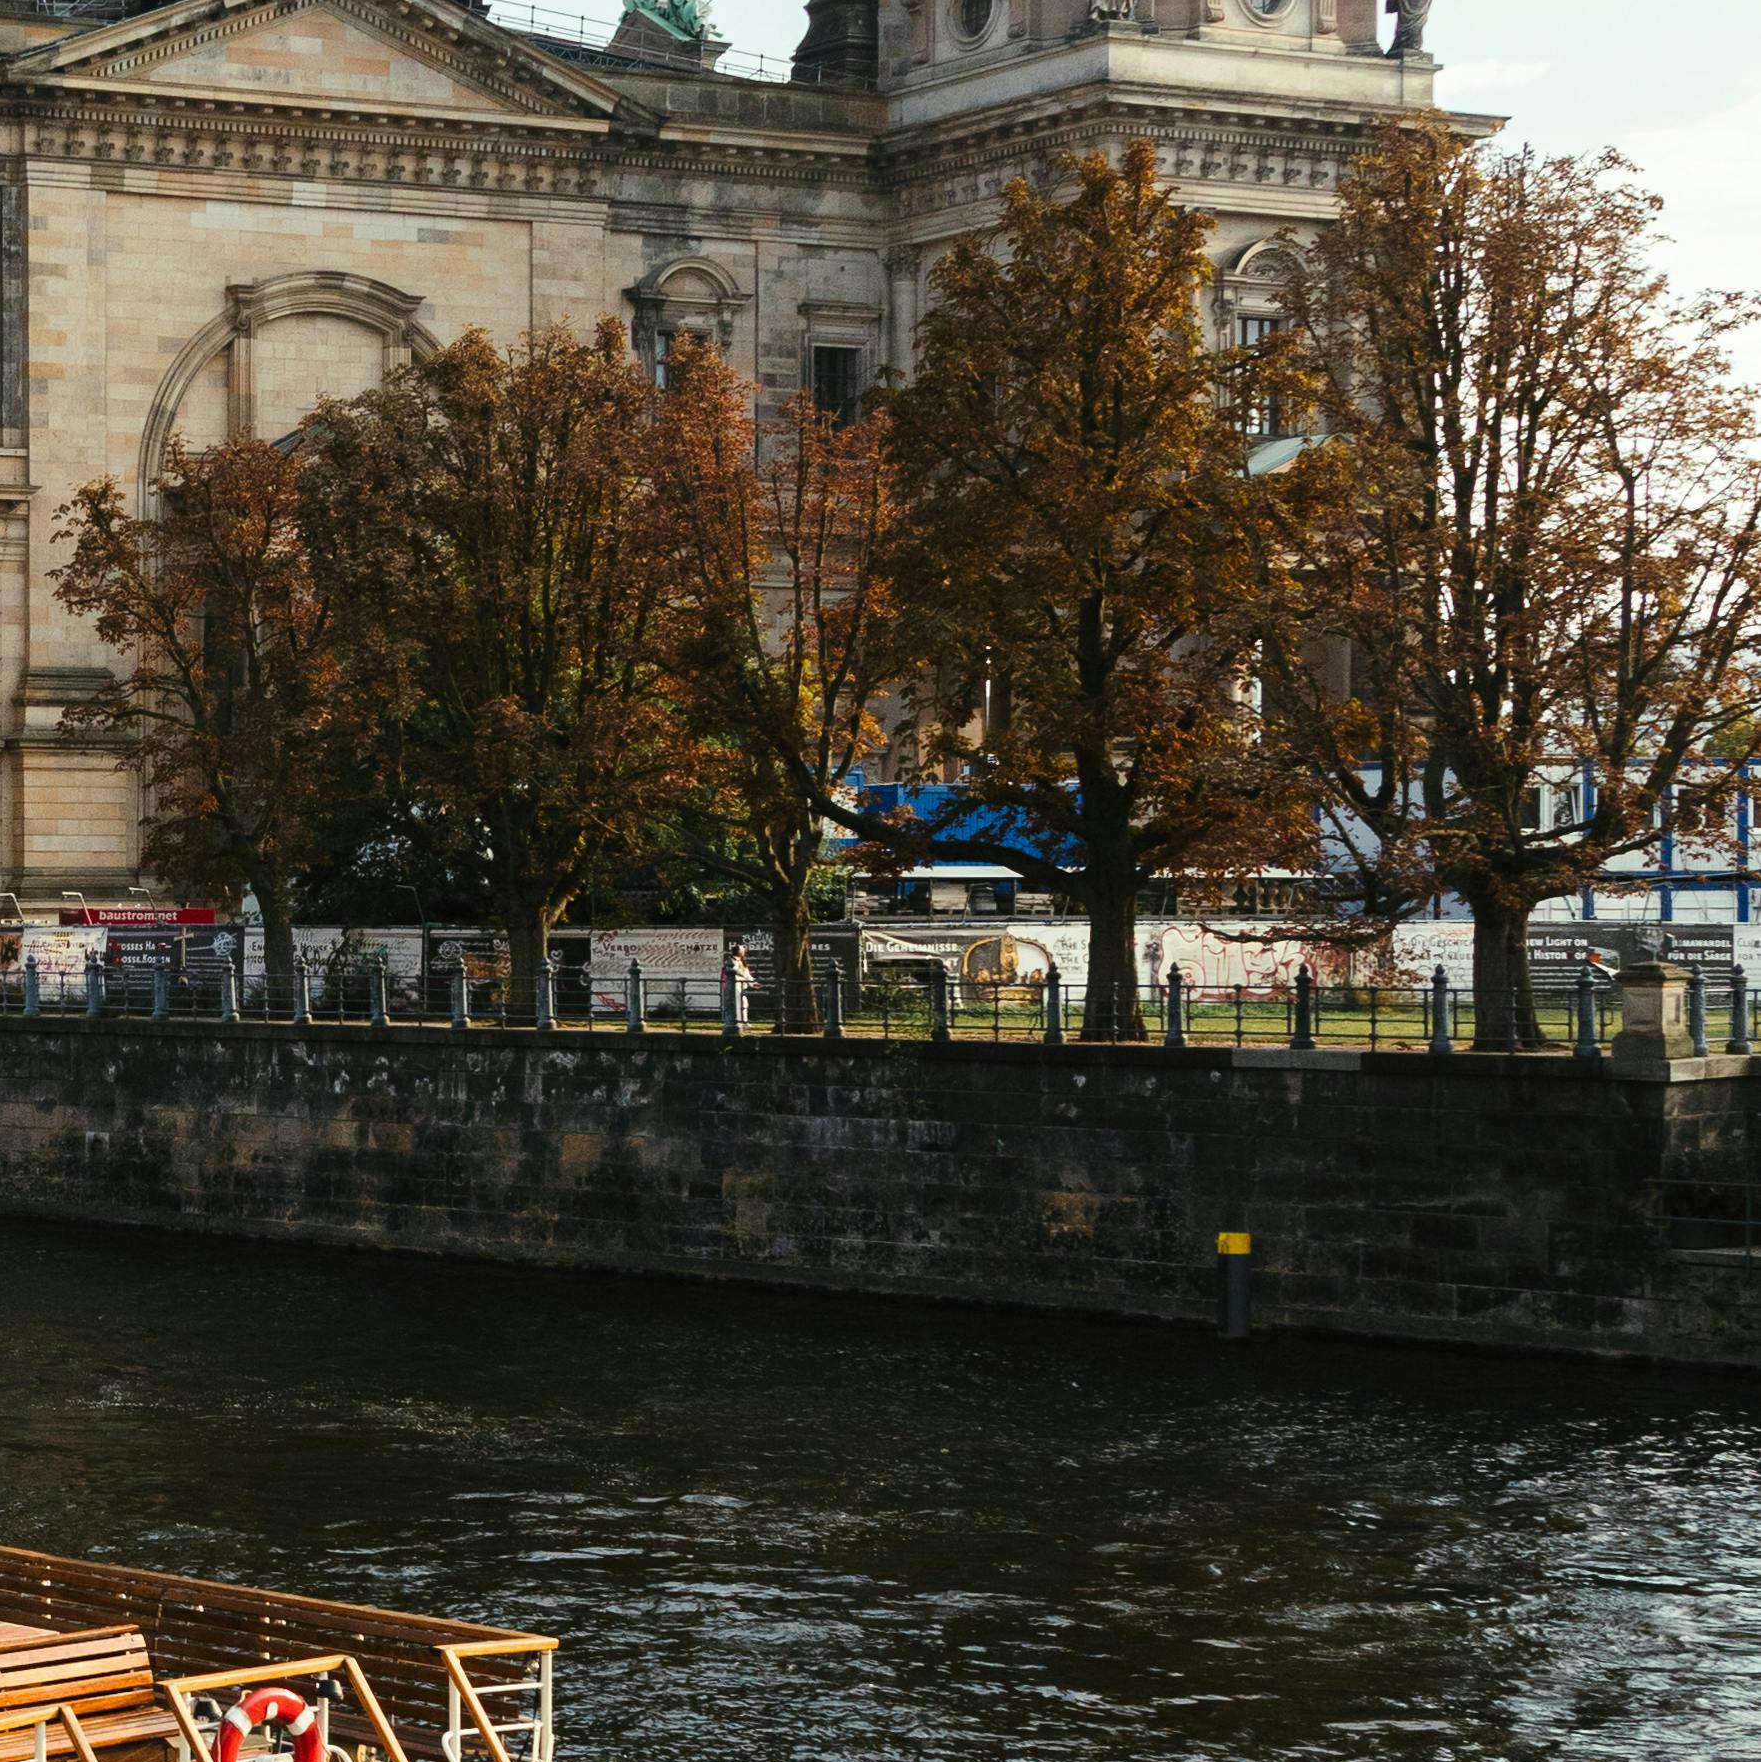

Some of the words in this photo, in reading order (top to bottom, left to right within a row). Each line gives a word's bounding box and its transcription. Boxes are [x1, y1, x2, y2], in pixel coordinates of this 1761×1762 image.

[99, 910, 178, 921] baustrom.net
[1545, 936, 1572, 947] LIGHT
[1574, 938, 1588, 947] ON
[866, 942, 884, 953] DIE
[1533, 949, 1570, 960] HISTOR
[1667, 950, 1685, 961] FÜR
[1687, 952, 1702, 961] DIE
